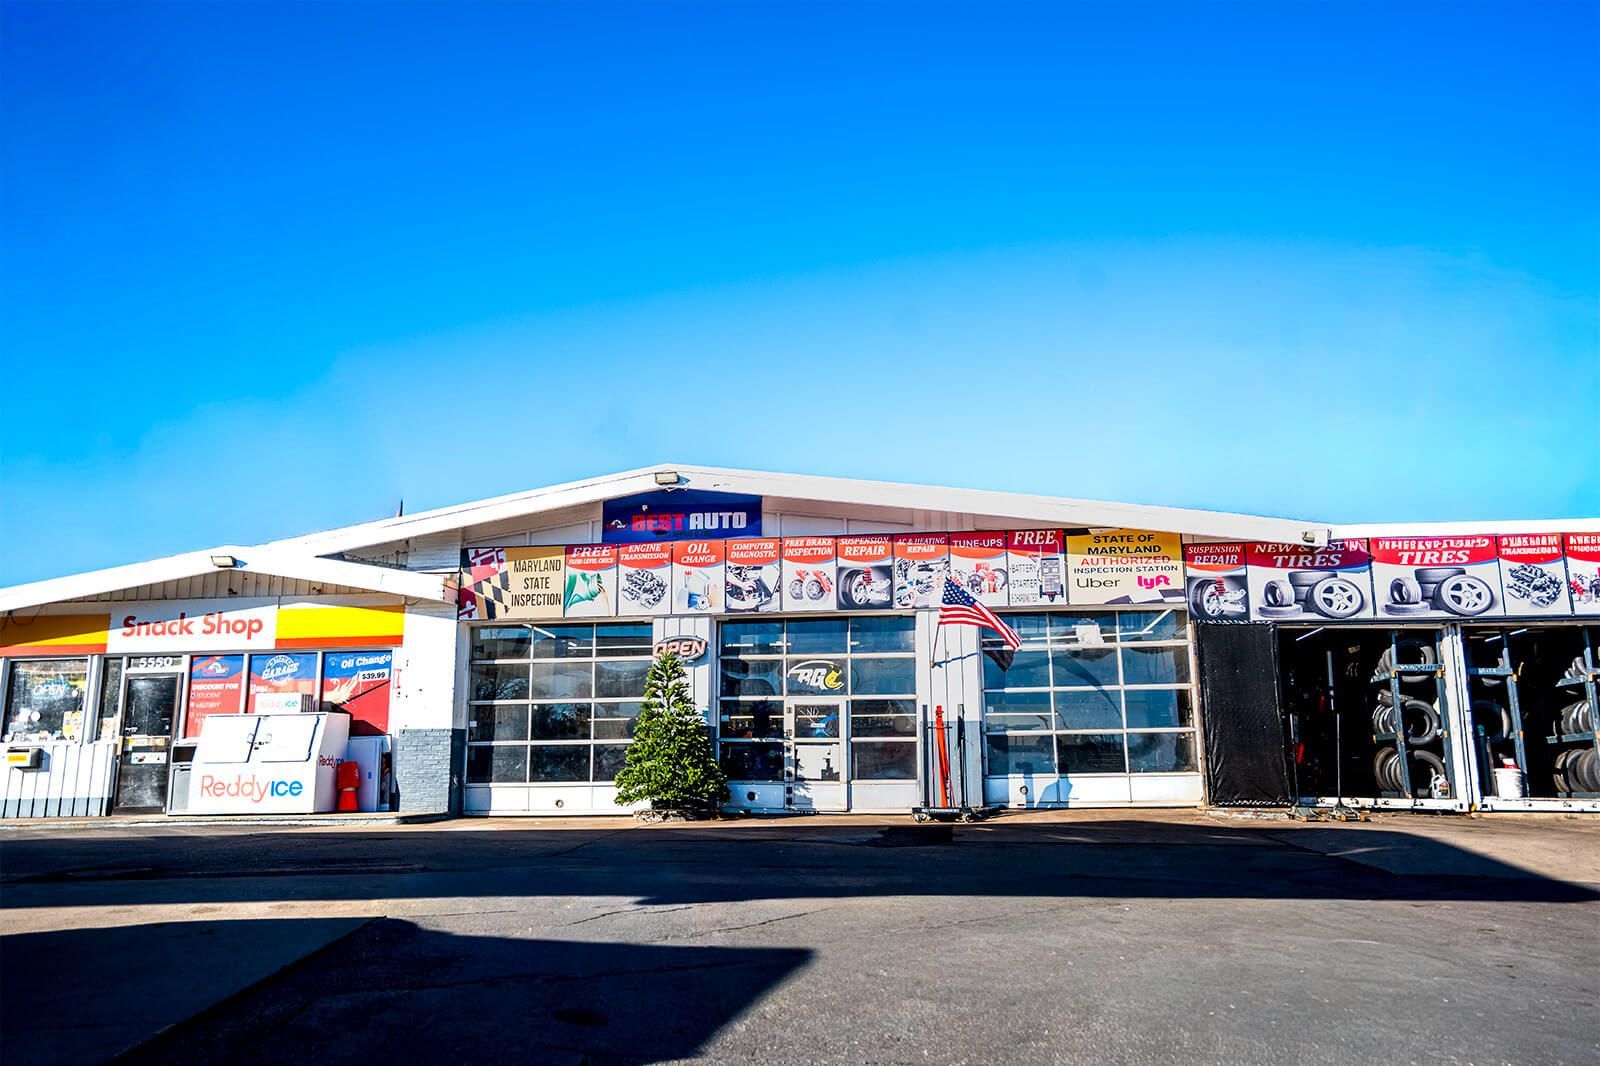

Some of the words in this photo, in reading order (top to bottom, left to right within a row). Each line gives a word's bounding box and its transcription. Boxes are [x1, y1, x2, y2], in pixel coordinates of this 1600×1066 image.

[632, 513, 685, 531] BEST
[689, 512, 747, 530] AUTO
[785, 539, 805, 547] FREE
[806, 538, 833, 546] BRAKE
[840, 536, 888, 545] SUSPENSION
[914, 537, 945, 545] HEATING
[1013, 530, 1056, 545] FREE
[1093, 535, 1134, 543] STATE
[1138, 534, 1155, 542] OF
[628, 543, 661, 552] ENGINE
[687, 543, 710, 554] OIL
[732, 542, 775, 550] COMPUTER
[953, 539, 1003, 548] TUNE-UPS
[1254, 543, 1294, 553] NEW
[571, 546, 612, 558] FREE
[731, 550, 777, 558] DIAGNOSTIC
[785, 547, 833, 556] INSPECTION
[845, 546, 885, 556] REPAIR
[907, 545, 936, 553] REPAIR
[1088, 545, 1162, 555] MARYLAND
[1188, 545, 1241, 554] SUSPENSION
[621, 551, 669, 560] TRANSMISSION
[681, 555, 716, 564] CHANGE
[1081, 555, 1171, 566] AUTHORIZED
[1194, 554, 1238, 565] REPAIR
[1273, 553, 1342, 568] TIRES
[1398, 550, 1471, 565] TIRES
[514, 559, 561, 573] MARYLAND
[1074, 566, 1133, 574] INSPECTION
[1135, 565, 1178, 573] STATION
[524, 576, 550, 589] STATE
[1077, 578, 1121, 588] Uber
[1137, 574, 1171, 590] lyft
[511, 592, 561, 607] INSPECTION
[121, 612, 194, 637] Snack
[202, 611, 263, 640] Shop
[652, 640, 707, 658] OPEN
[139, 656, 173, 668] 5550
[362, 672, 385, 680] $39.99
